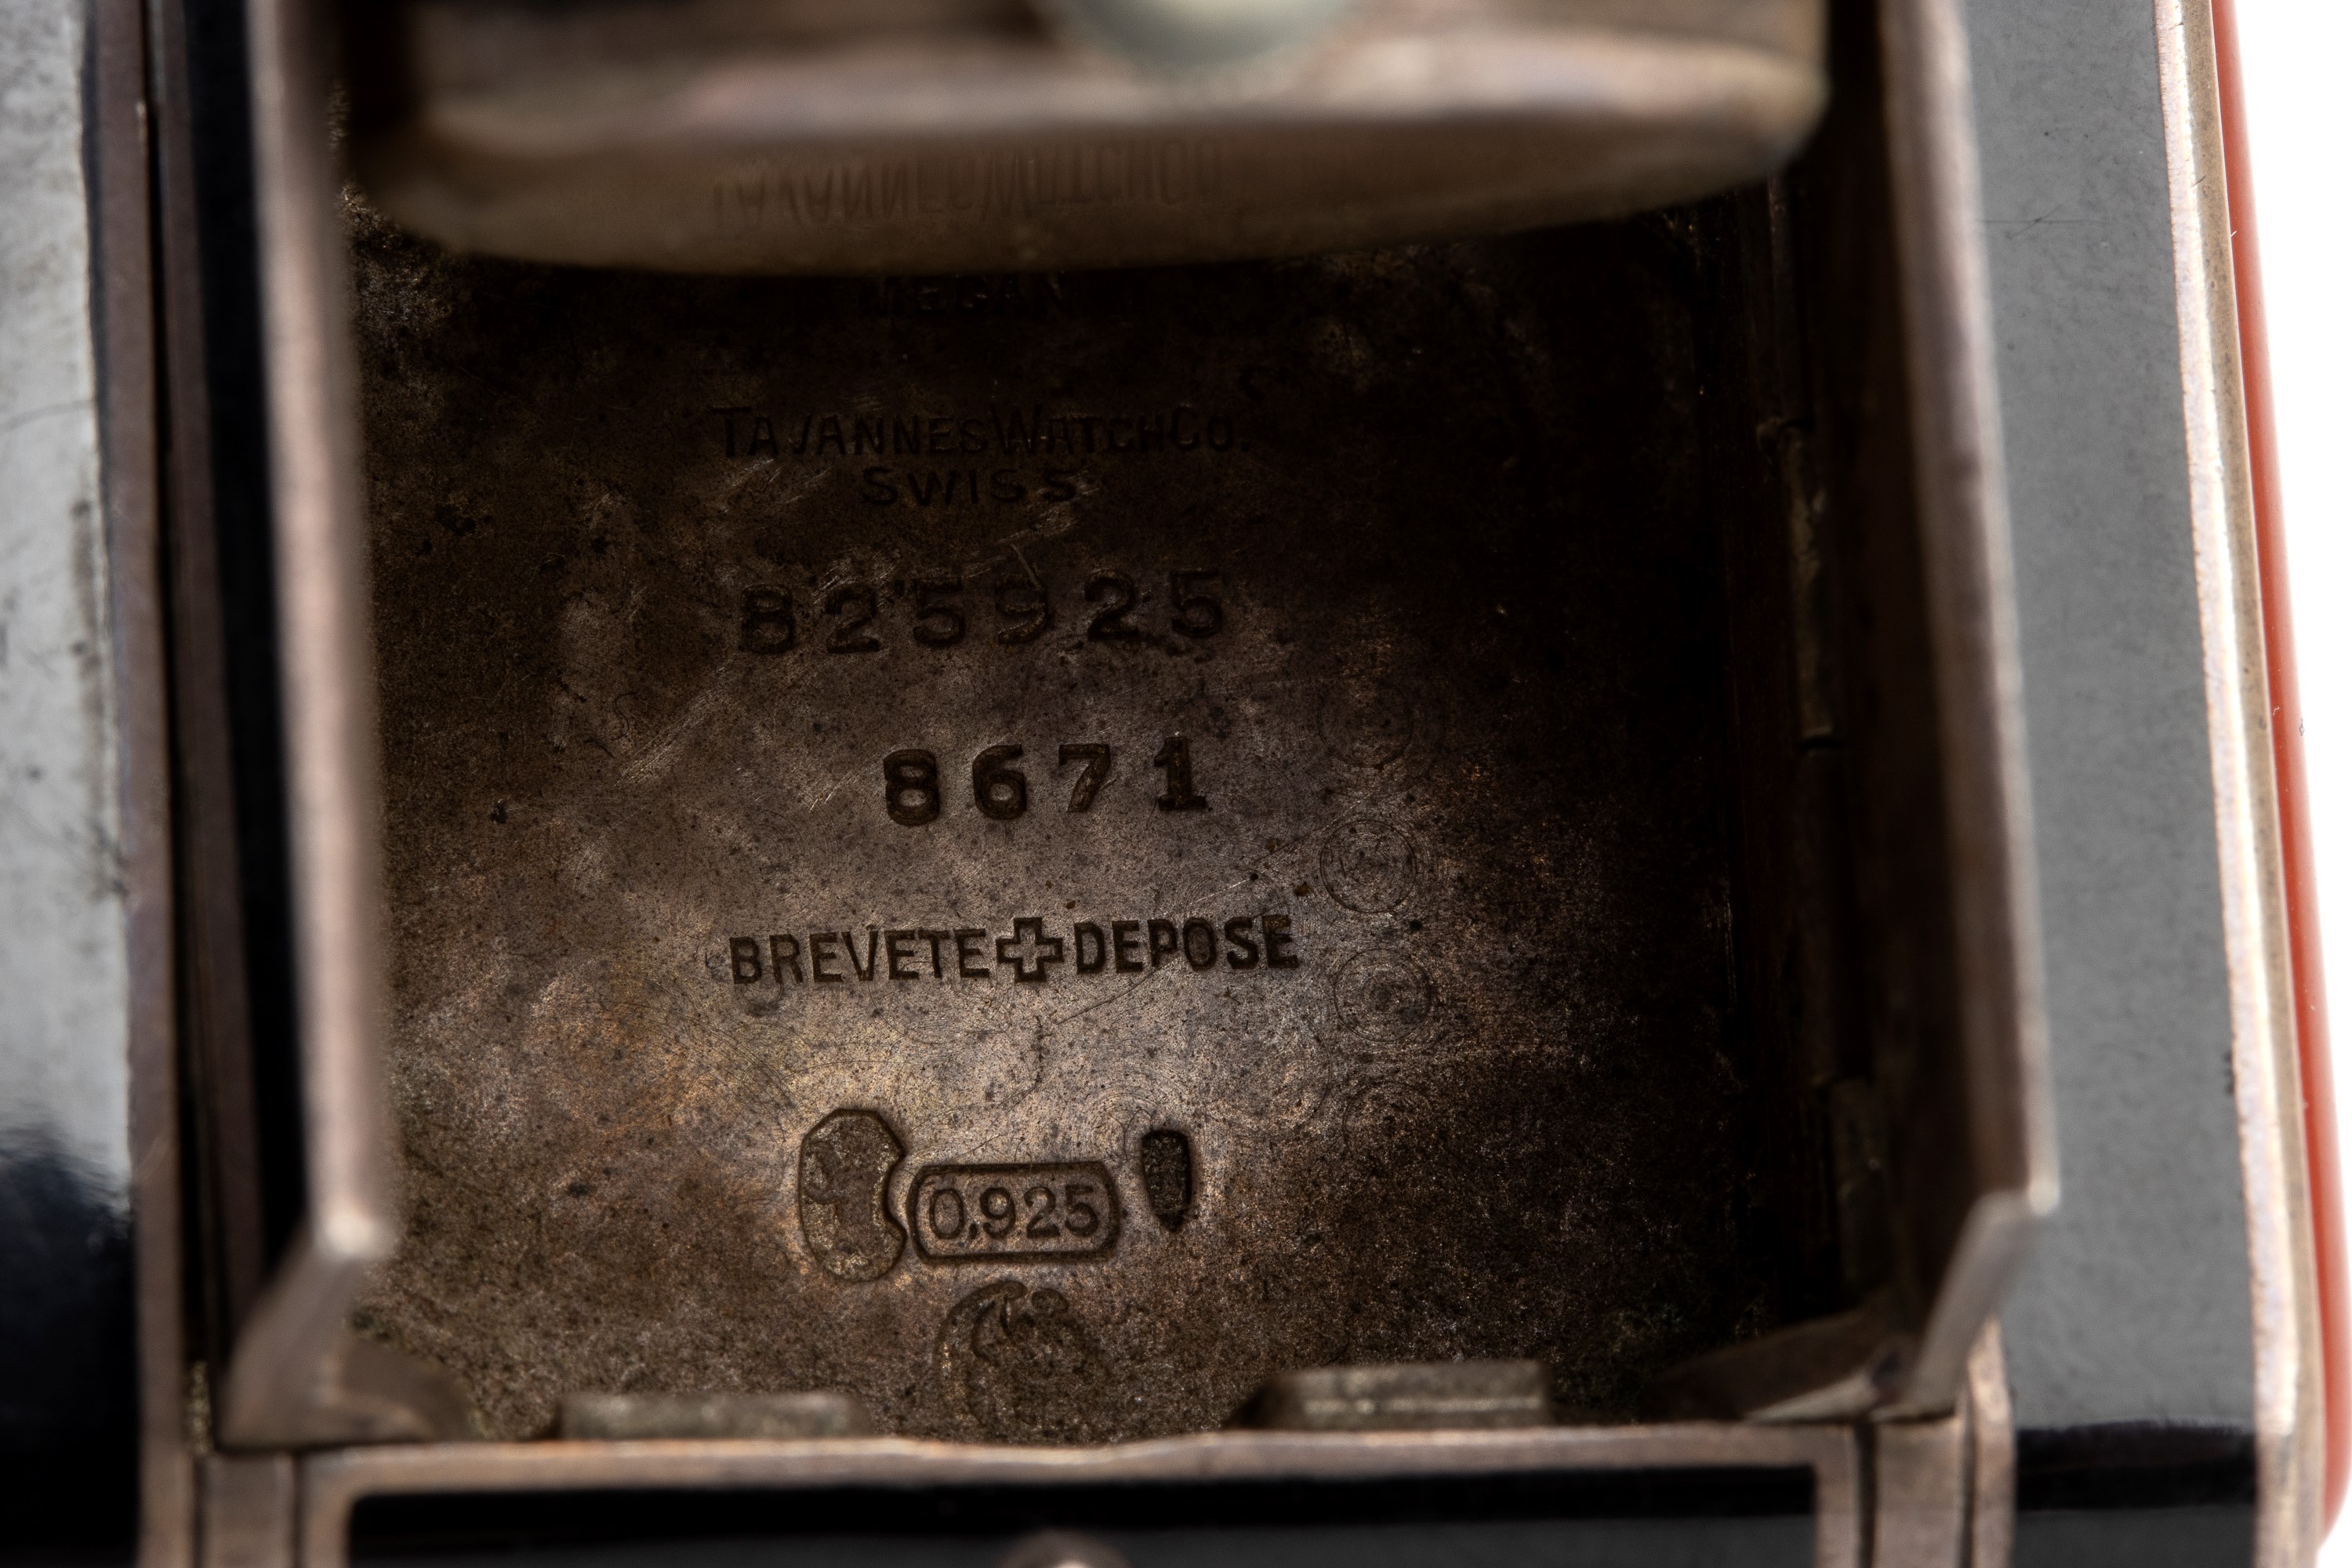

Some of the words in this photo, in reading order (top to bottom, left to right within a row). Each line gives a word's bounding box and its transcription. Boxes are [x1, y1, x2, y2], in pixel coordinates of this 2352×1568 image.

[862, 466, 1079, 506] SWISS
[739, 568, 1225, 655] 825925
[882, 734, 1208, 827] 8671
[728, 925, 991, 985] BREVETE
[1073, 913, 1300, 976] DEPOSE
